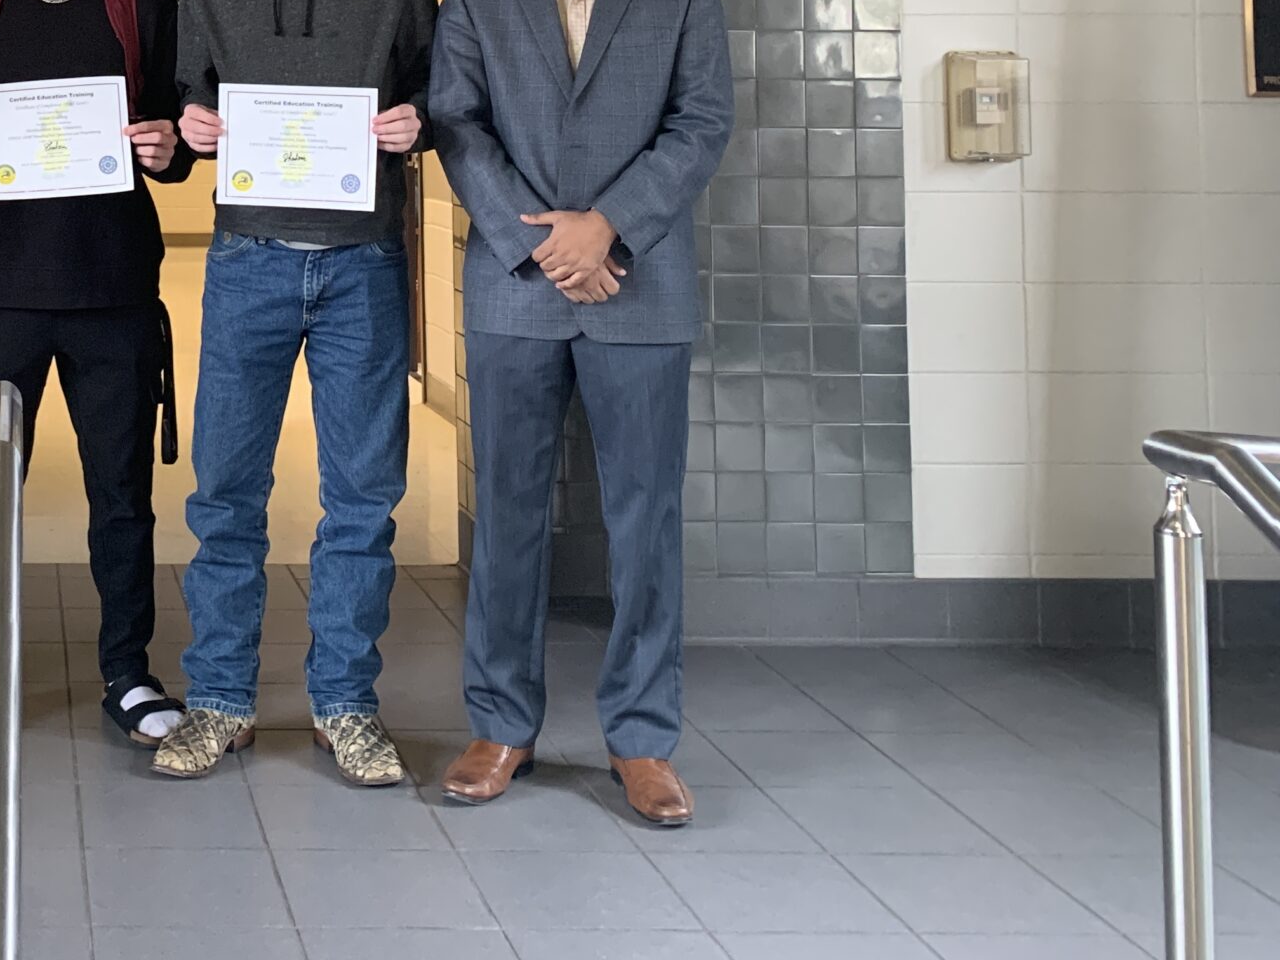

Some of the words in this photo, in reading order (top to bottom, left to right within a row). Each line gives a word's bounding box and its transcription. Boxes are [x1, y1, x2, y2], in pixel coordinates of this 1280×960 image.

[9, 95, 36, 103] Certified
[36, 93, 67, 101] Education
[69, 91, 94, 99] Training
[316, 101, 343, 109] Training
